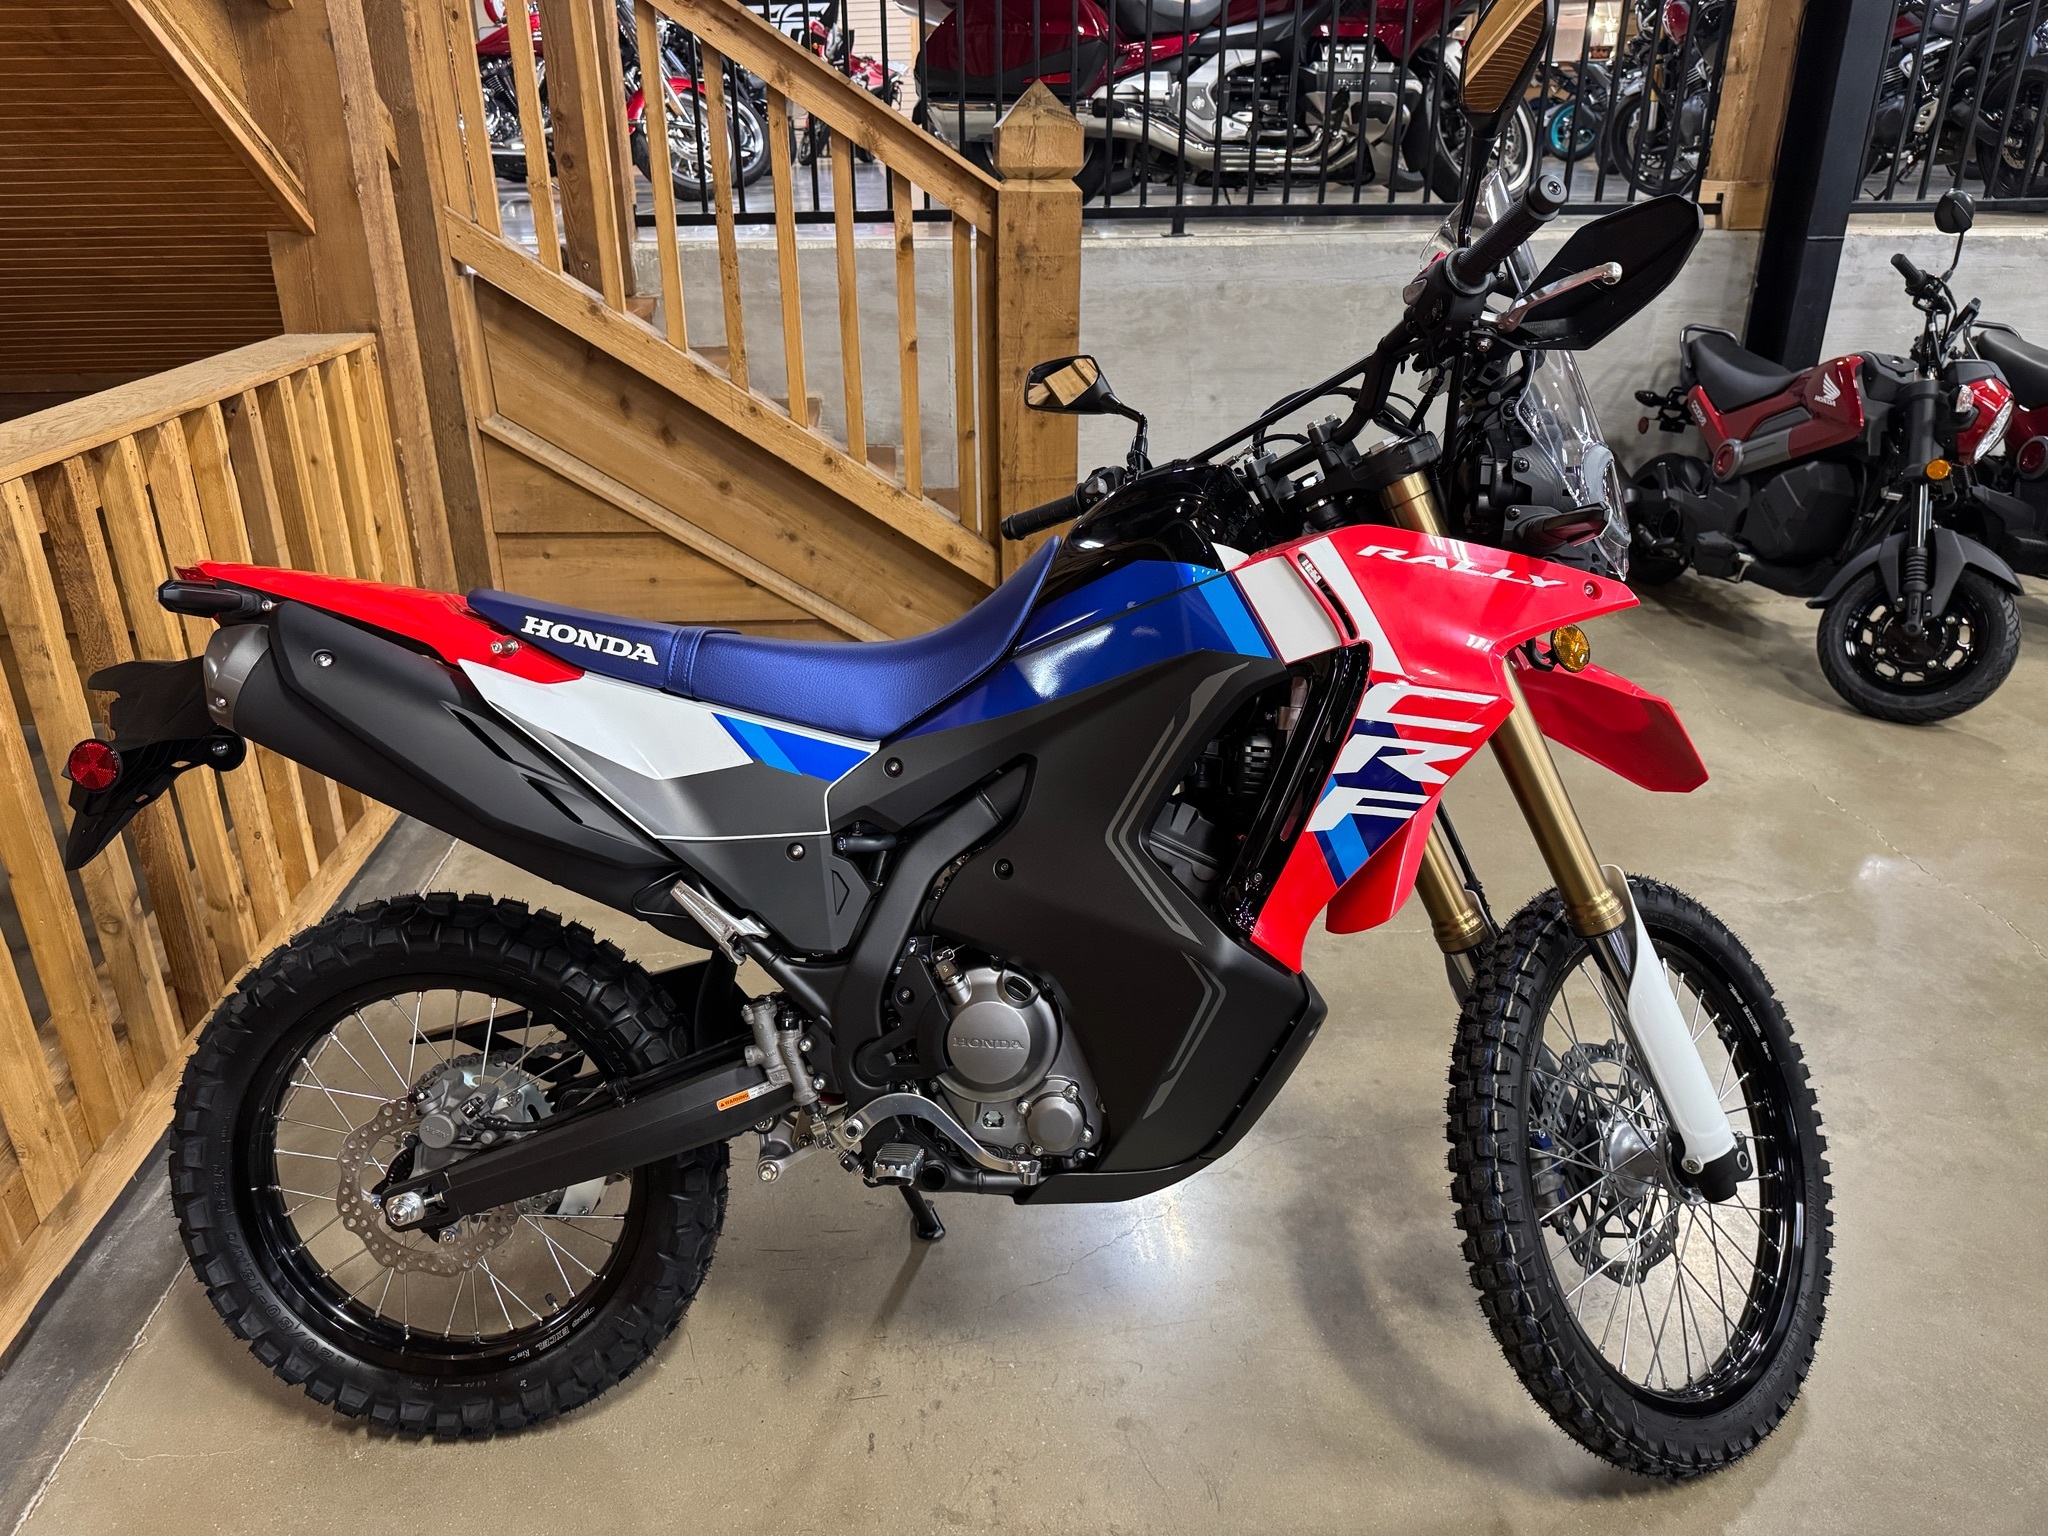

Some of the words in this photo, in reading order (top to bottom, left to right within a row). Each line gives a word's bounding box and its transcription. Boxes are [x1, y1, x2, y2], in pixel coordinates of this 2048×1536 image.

[1814, 395, 1836, 407] HONDA
[1356, 544, 1567, 589] RALLY
[520, 615, 660, 666] HONDA
[1306, 681, 1502, 833] CRF
[952, 1037, 1025, 1050] HONDA
[725, 1090, 750, 1107] WARNING
[535, 1326, 571, 1352] EXCEL
